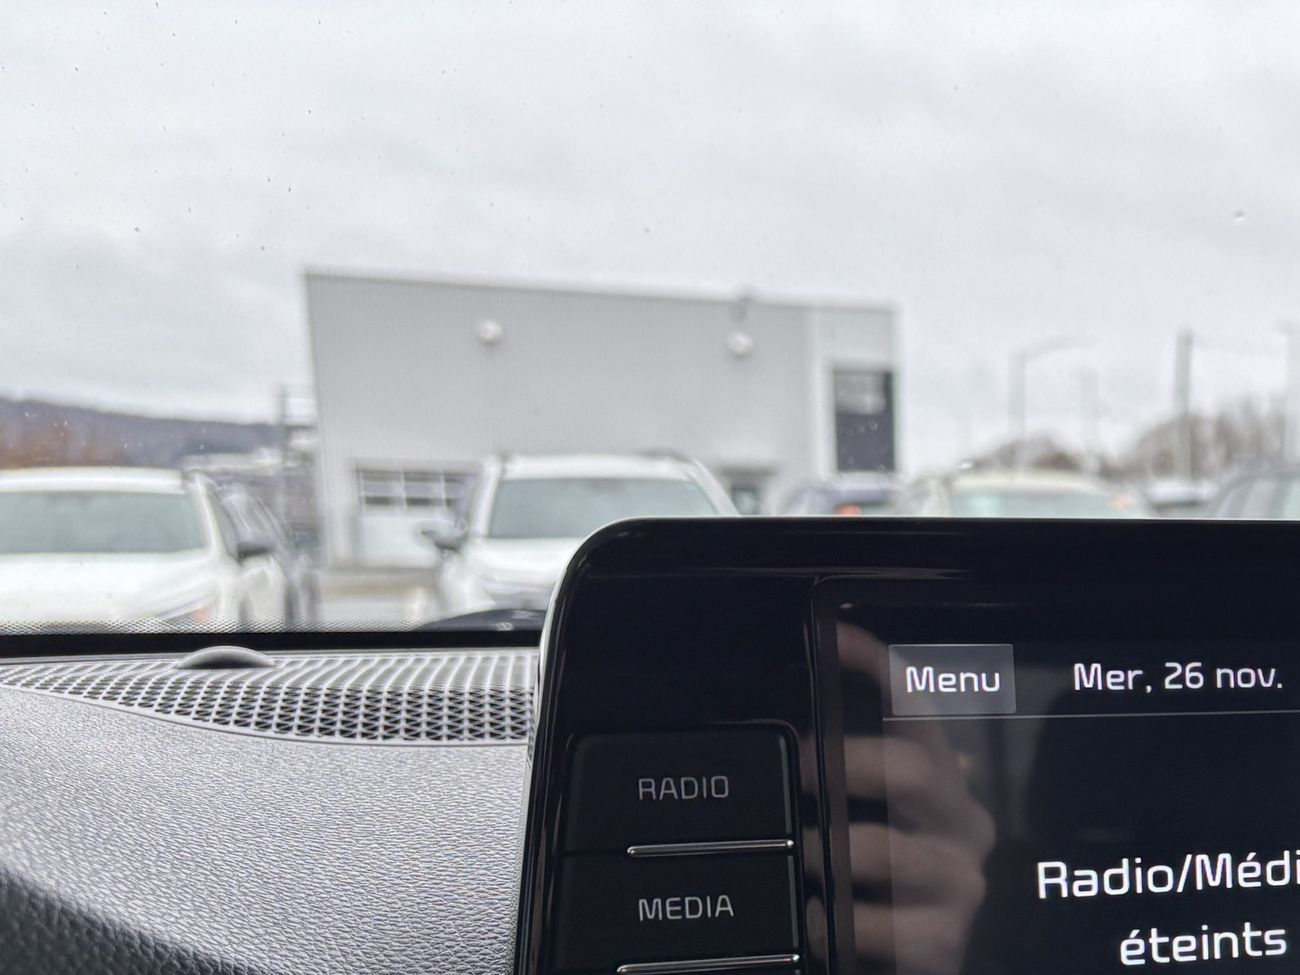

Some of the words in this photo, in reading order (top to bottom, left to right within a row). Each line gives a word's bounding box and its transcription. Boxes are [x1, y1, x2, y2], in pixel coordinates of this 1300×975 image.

[905, 666, 1000, 694] Menu
[1164, 661, 1205, 690] 26
[1216, 667, 1283, 689] nov.
[638, 775, 729, 801] RADIO
[638, 894, 735, 922] MEDIA
[1119, 921, 1288, 966] éteints
